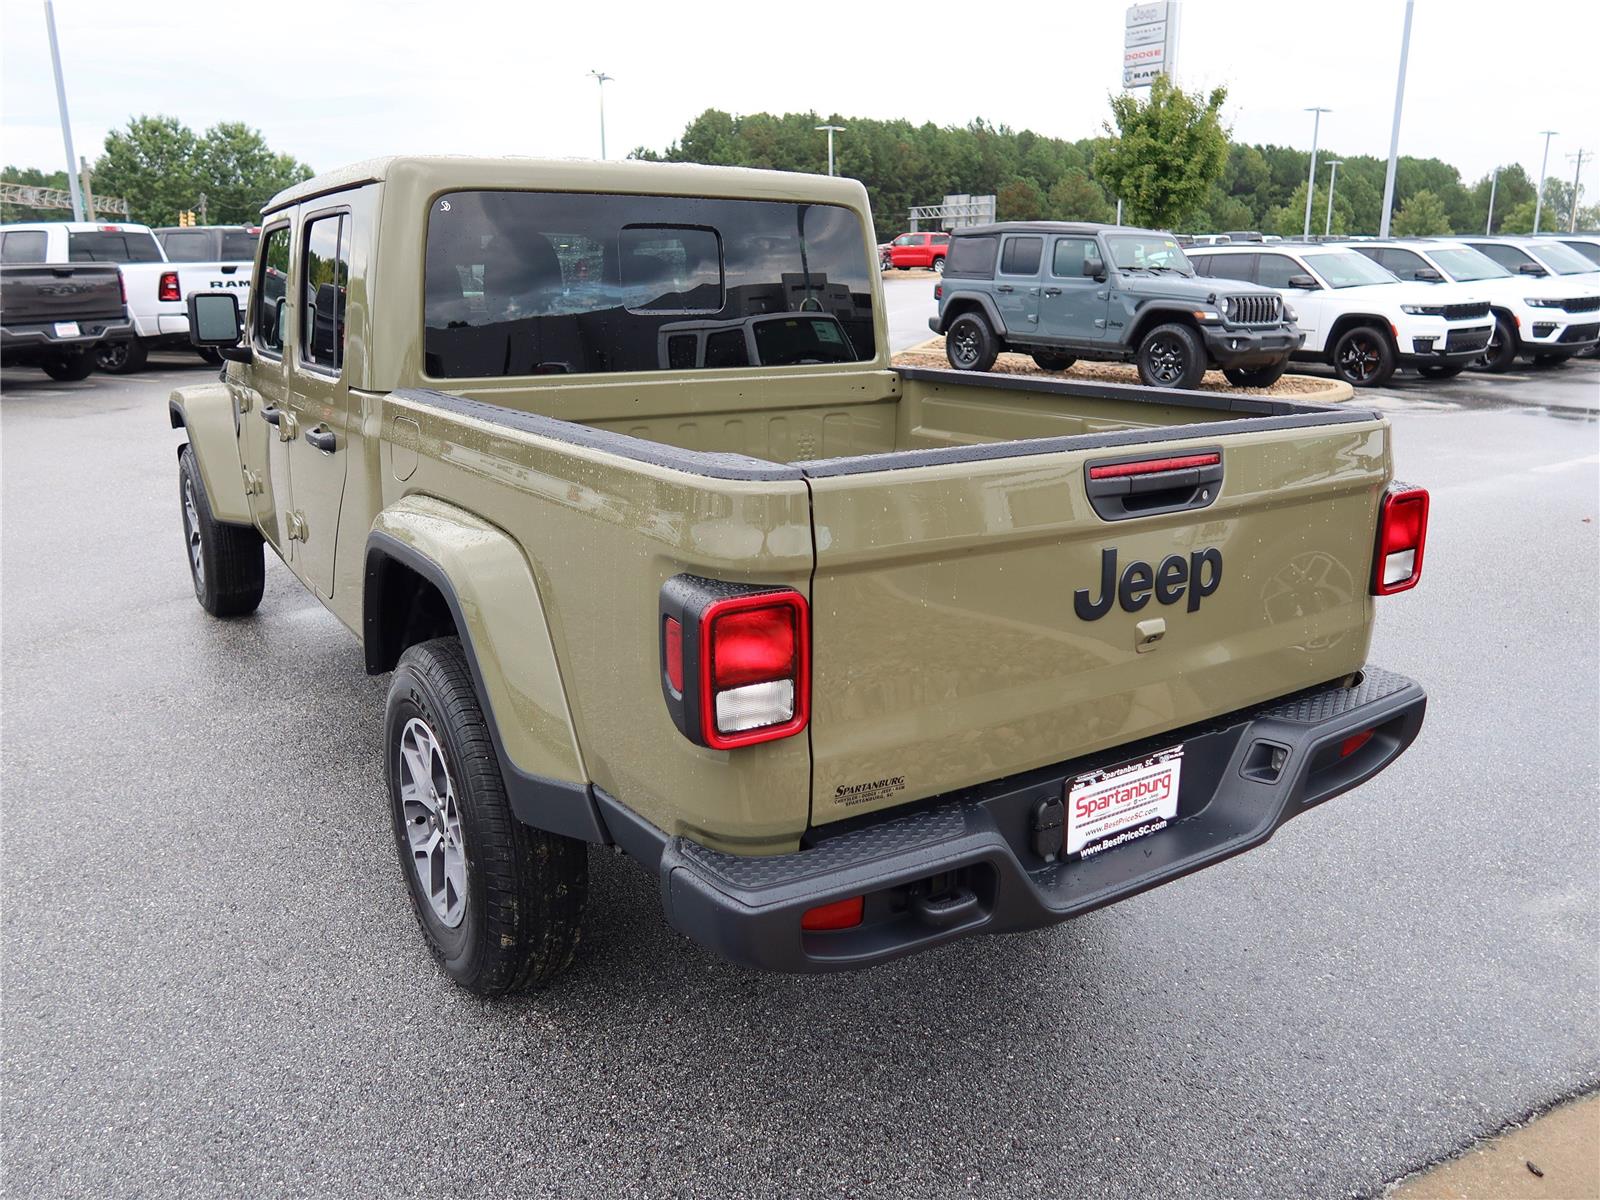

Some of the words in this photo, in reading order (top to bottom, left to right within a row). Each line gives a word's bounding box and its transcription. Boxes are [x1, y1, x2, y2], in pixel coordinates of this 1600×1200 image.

[1125, 49, 1162, 61] DODGE
[1134, 69, 1160, 79] RAM
[209, 280, 250, 288] RAM
[1074, 545, 1223, 621] Jeep
[1101, 762, 1143, 780] Spartanburg,
[1145, 758, 1153, 767] SC
[1076, 774, 1171, 818] Spartanburg
[1085, 806, 1158, 837] www.BestPriceSC.com
[1080, 819, 1167, 858] www.BestPriceSC.com
